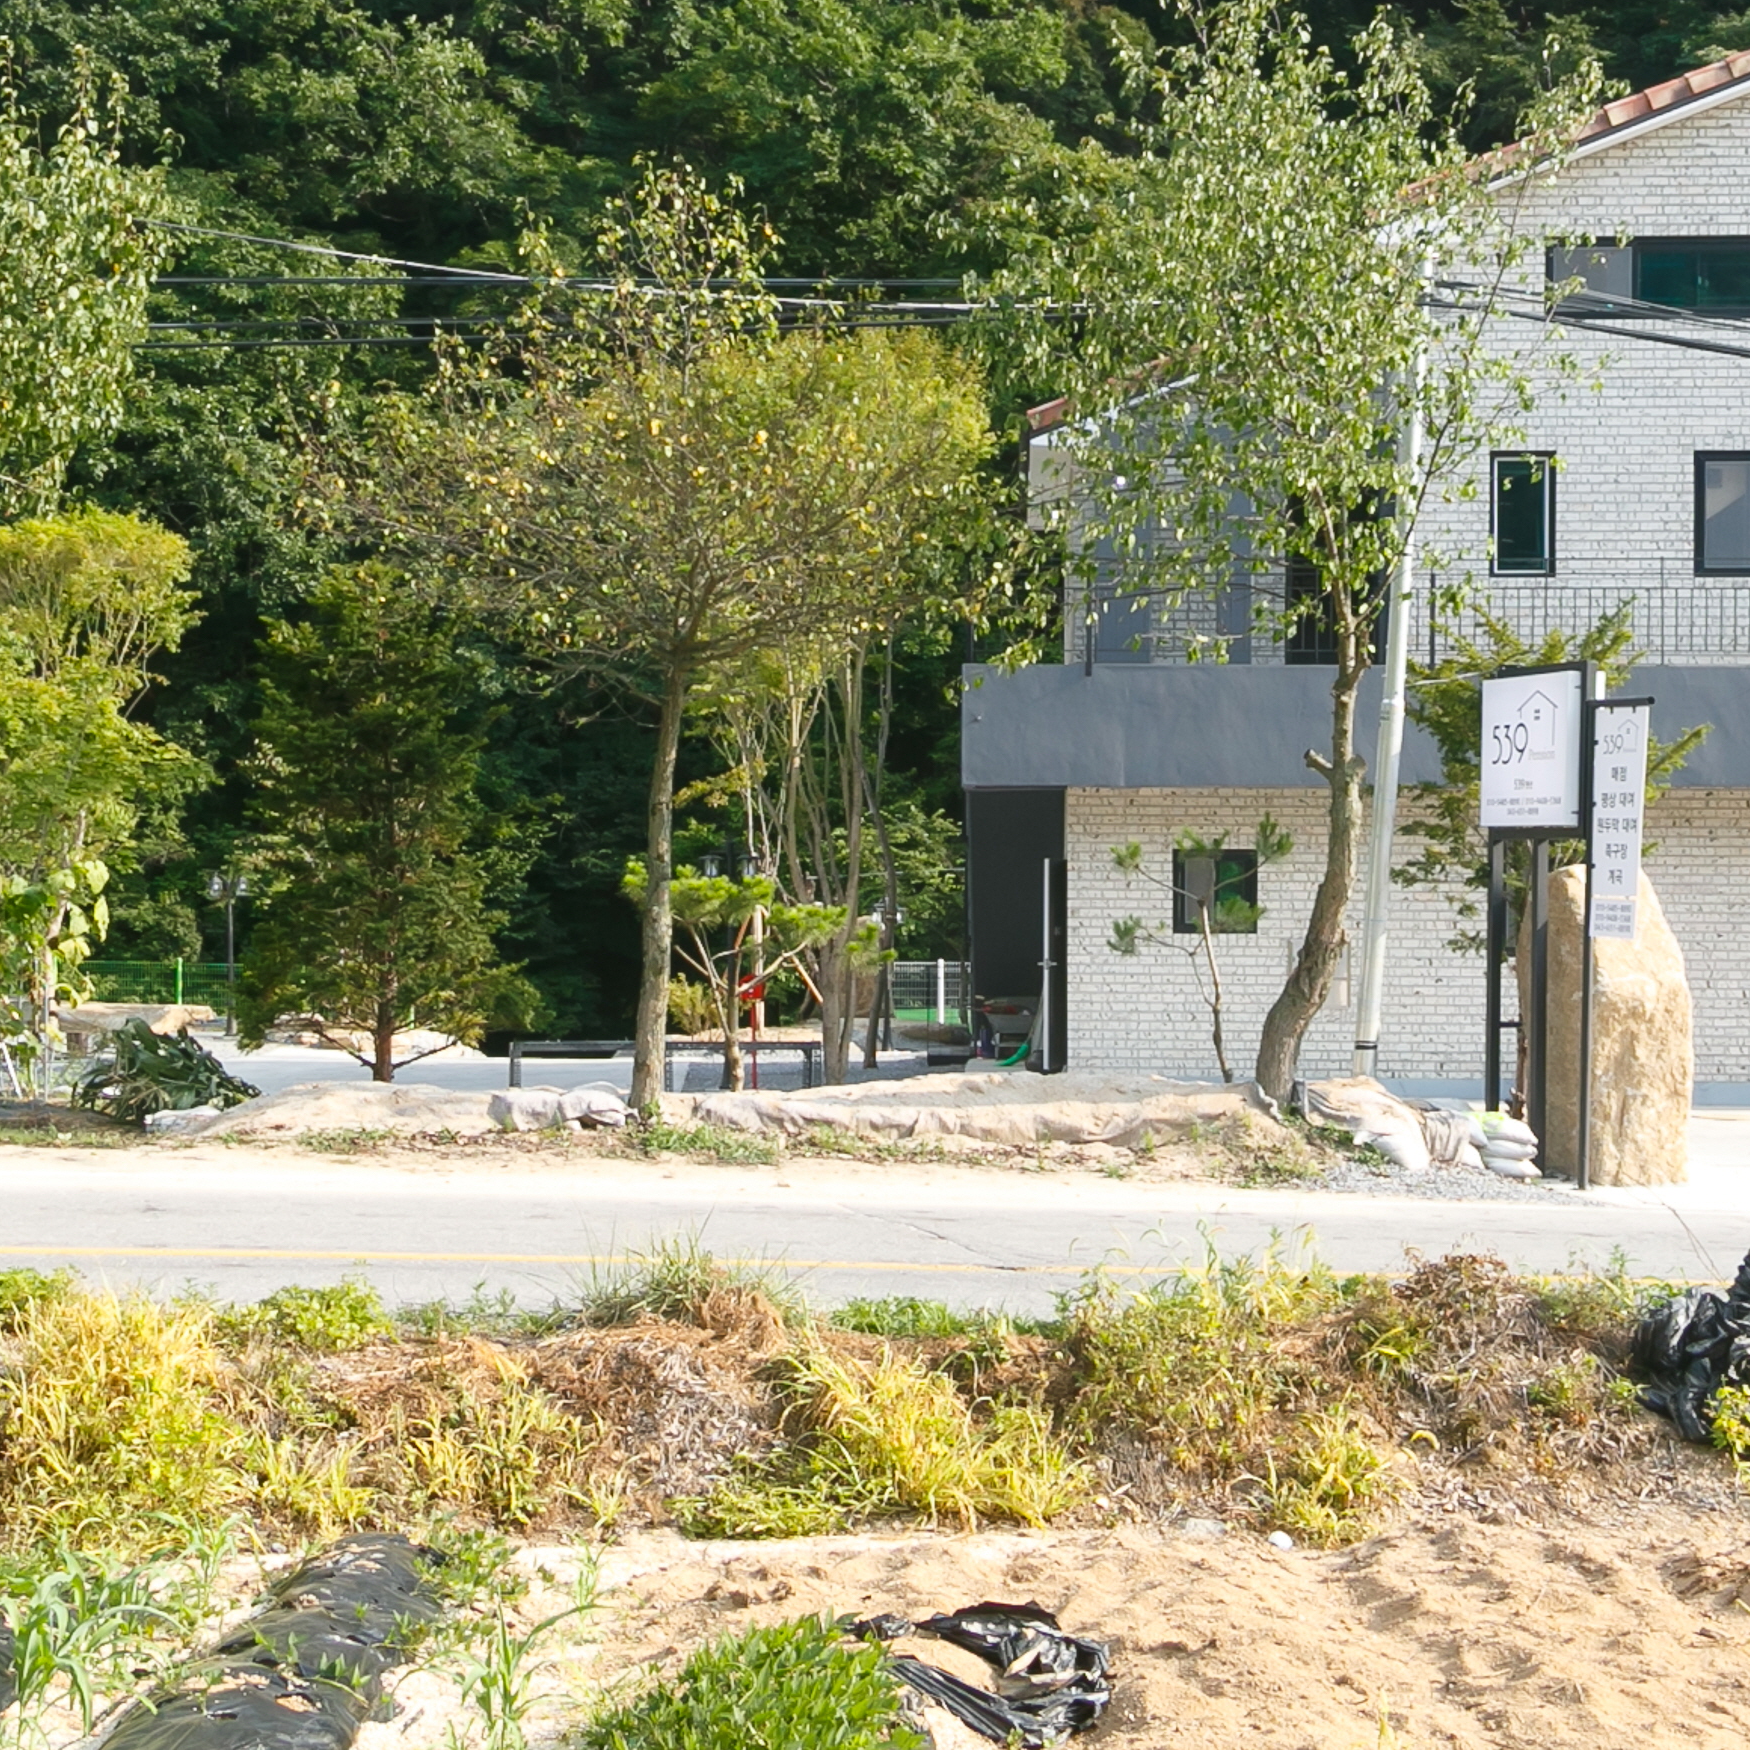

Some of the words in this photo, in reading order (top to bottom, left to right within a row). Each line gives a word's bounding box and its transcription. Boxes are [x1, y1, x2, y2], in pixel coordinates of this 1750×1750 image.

[1492, 723, 1528, 765] 539
[1603, 734, 1624, 755] 539
[1611, 766, 1627, 782] 매점
[1601, 792, 1617, 808] 평상
[1619, 792, 1635, 807] 대여
[1597, 817, 1620, 833] 원두막
[1622, 817, 1638, 833] 대여
[1605, 843, 1628, 859] 족구장
[1607, 869, 1623, 885] 계곡
